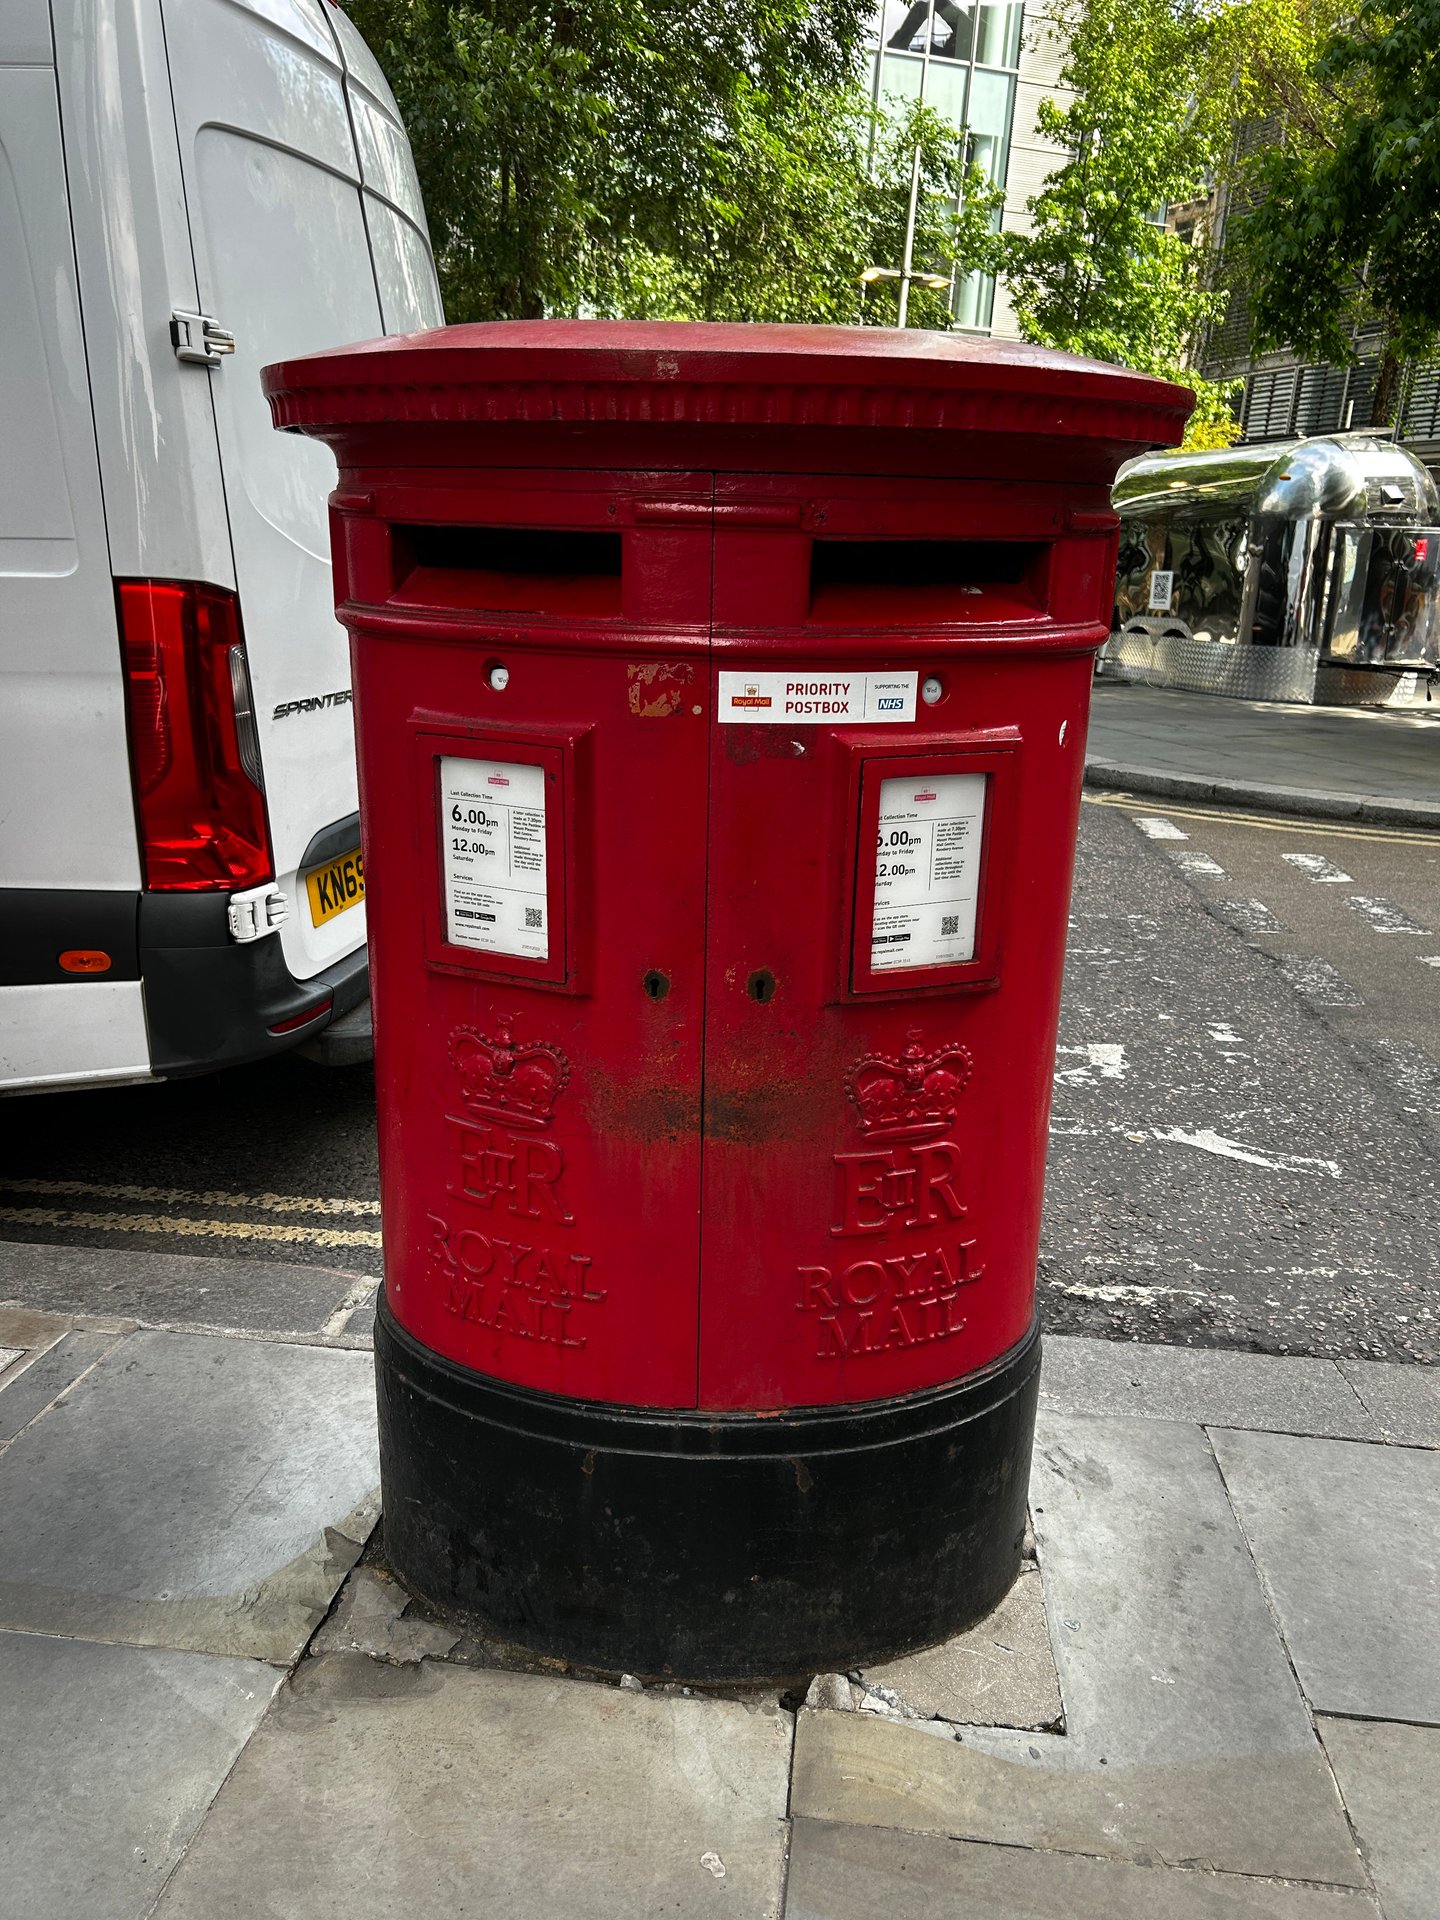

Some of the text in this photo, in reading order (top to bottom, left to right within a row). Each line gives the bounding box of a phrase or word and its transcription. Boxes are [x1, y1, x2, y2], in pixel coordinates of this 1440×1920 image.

[786, 683, 850, 696] PRIORITY
[272, 690, 352, 720] SPRINTER
[786, 702, 850, 714] POSTBOX
[880, 699, 902, 709] NHS
[452, 804, 498, 827] 6.00pm
[452, 825, 470, 833] Monday
[478, 828, 492, 836] Friday
[452, 838, 496, 856] 12.00pm
[453, 854, 474, 863] Saturday
[876, 864, 916, 877] 2.00pm
[317, 855, 364, 914] KN69
[427, 1211, 608, 1304] ROYAL
[795, 1238, 986, 1310] ROYAL
[443, 1268, 588, 1349] MAIL
[815, 1292, 968, 1358] MAIL
